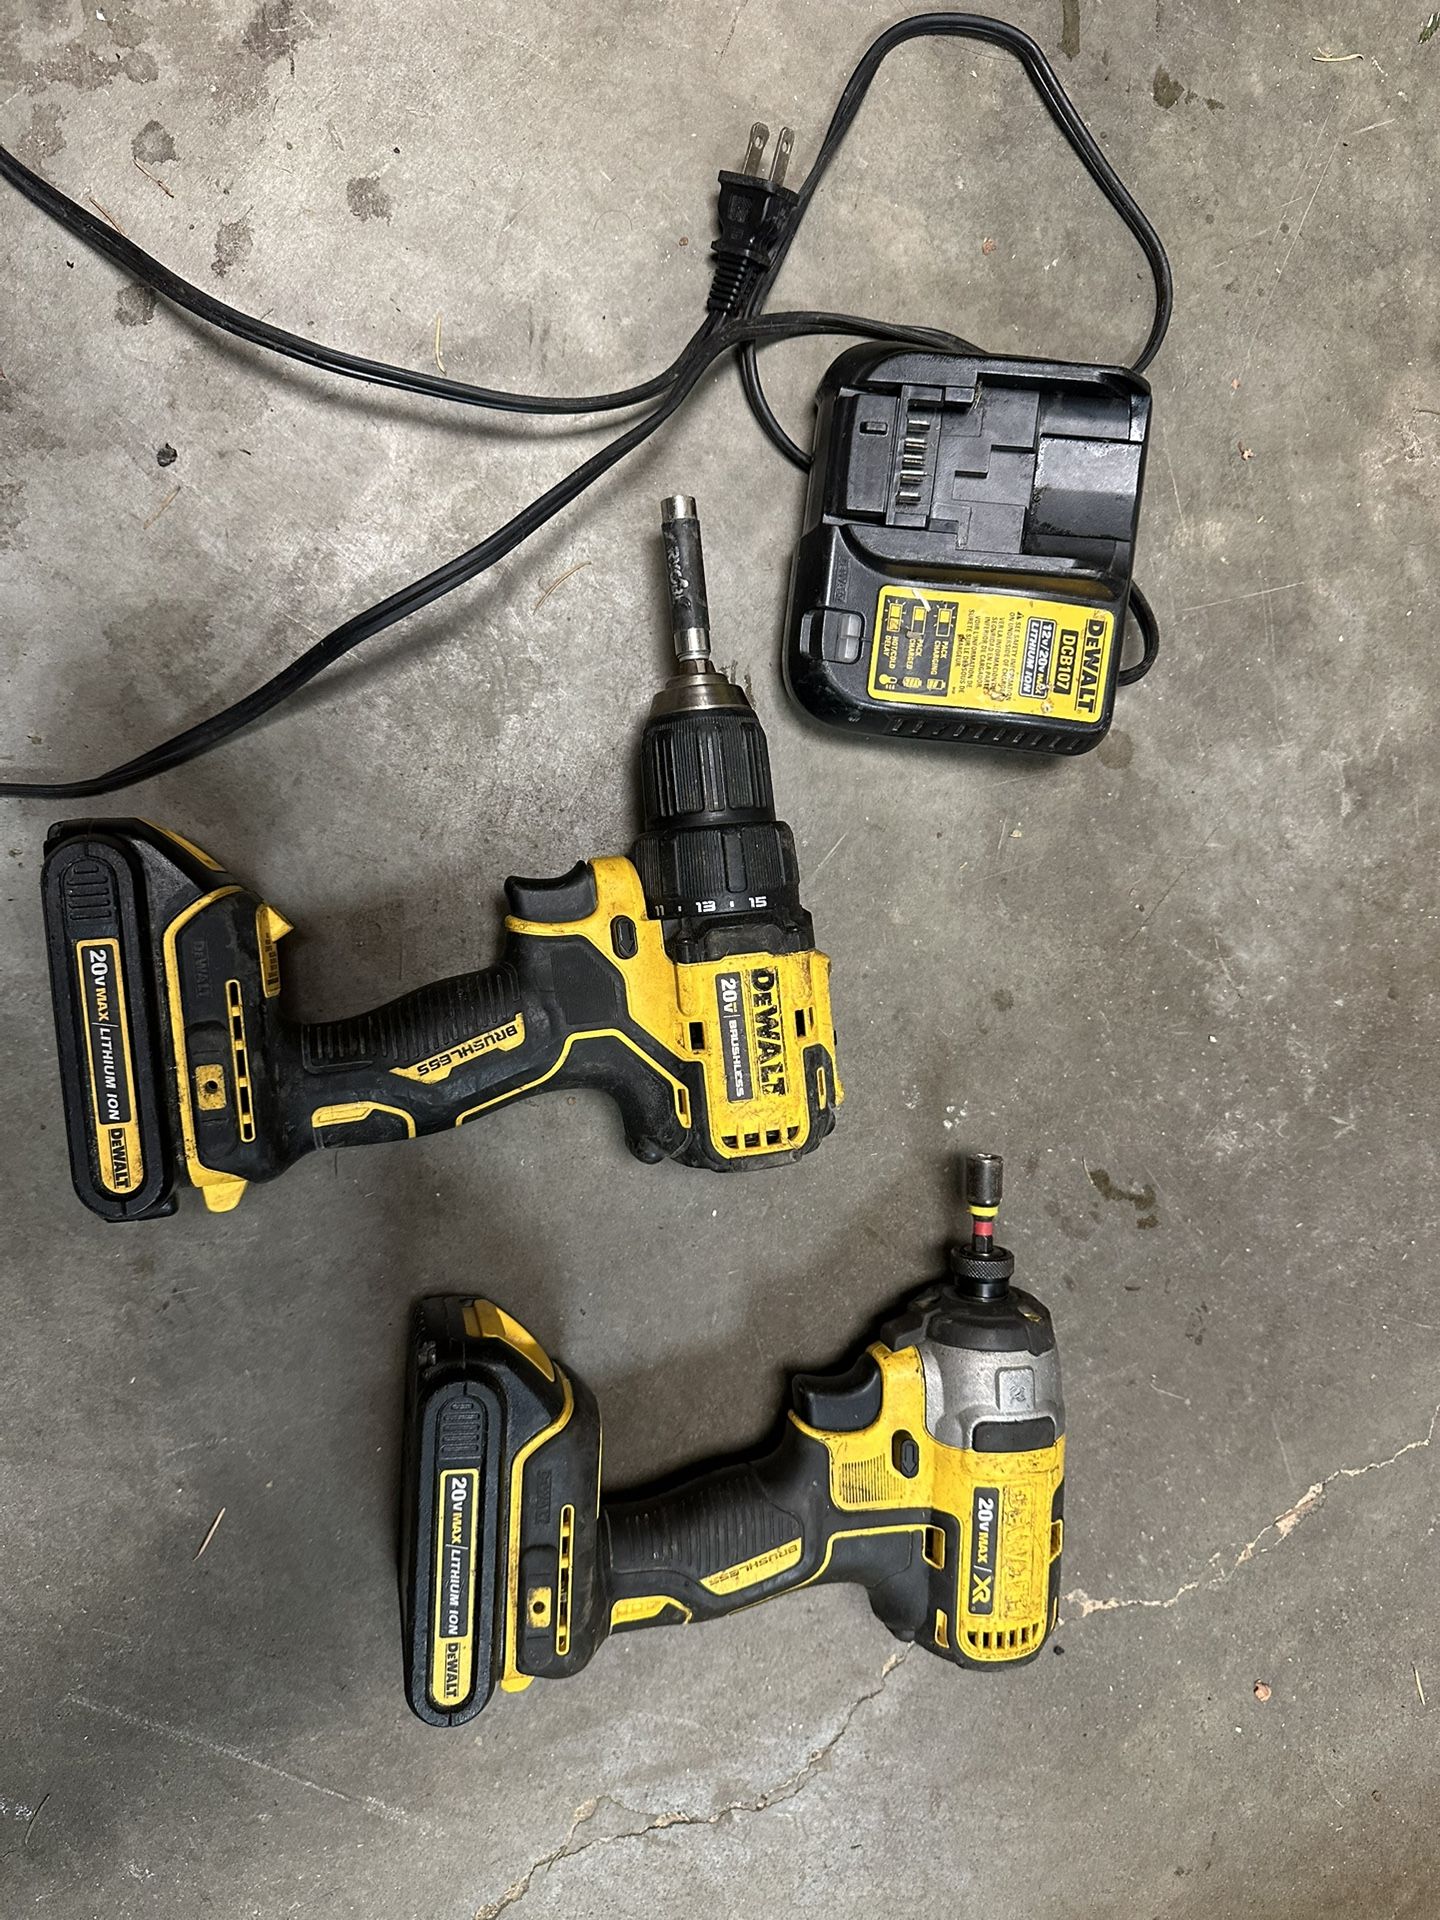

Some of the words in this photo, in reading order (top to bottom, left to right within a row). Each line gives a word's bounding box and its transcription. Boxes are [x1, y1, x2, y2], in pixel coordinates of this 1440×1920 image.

[1008, 611, 1015, 621] ON
[883, 635, 891, 656] DELAY
[888, 635, 898, 669] HOT/COLD
[906, 638, 915, 669] CHARGED
[915, 638, 923, 657] PACK
[930, 640, 940, 675] CHARGING
[940, 640, 948, 659] PACK
[1025, 621, 1038, 669] LITHIUM
[1055, 634, 1075, 690] DCB107
[1022, 670, 1032, 692] ION
[1077, 619, 1104, 712] DEWALT
[958, 685, 965, 693] DE
[695, 900, 716, 912] 13
[748, 896, 767, 907] 15
[94, 987, 109, 1021] MAX
[751, 967, 785, 1097] DEWALT
[99, 1027, 114, 1089] LITHIUM
[417, 1025, 518, 1076] BRUSHLESS
[728, 1019, 744, 1097] BRUSHLESS
[106, 1092, 119, 1120] ION
[110, 1128, 128, 1188] DEWALT
[450, 1512, 462, 1544] MAX
[976, 1531, 989, 1564] MAX
[448, 1548, 462, 1605] LITHIUM
[709, 1544, 799, 1586] BRUSHLESS
[971, 1573, 991, 1604] XR
[448, 1610, 459, 1634] ION
[443, 1642, 459, 1697] DEWALT
